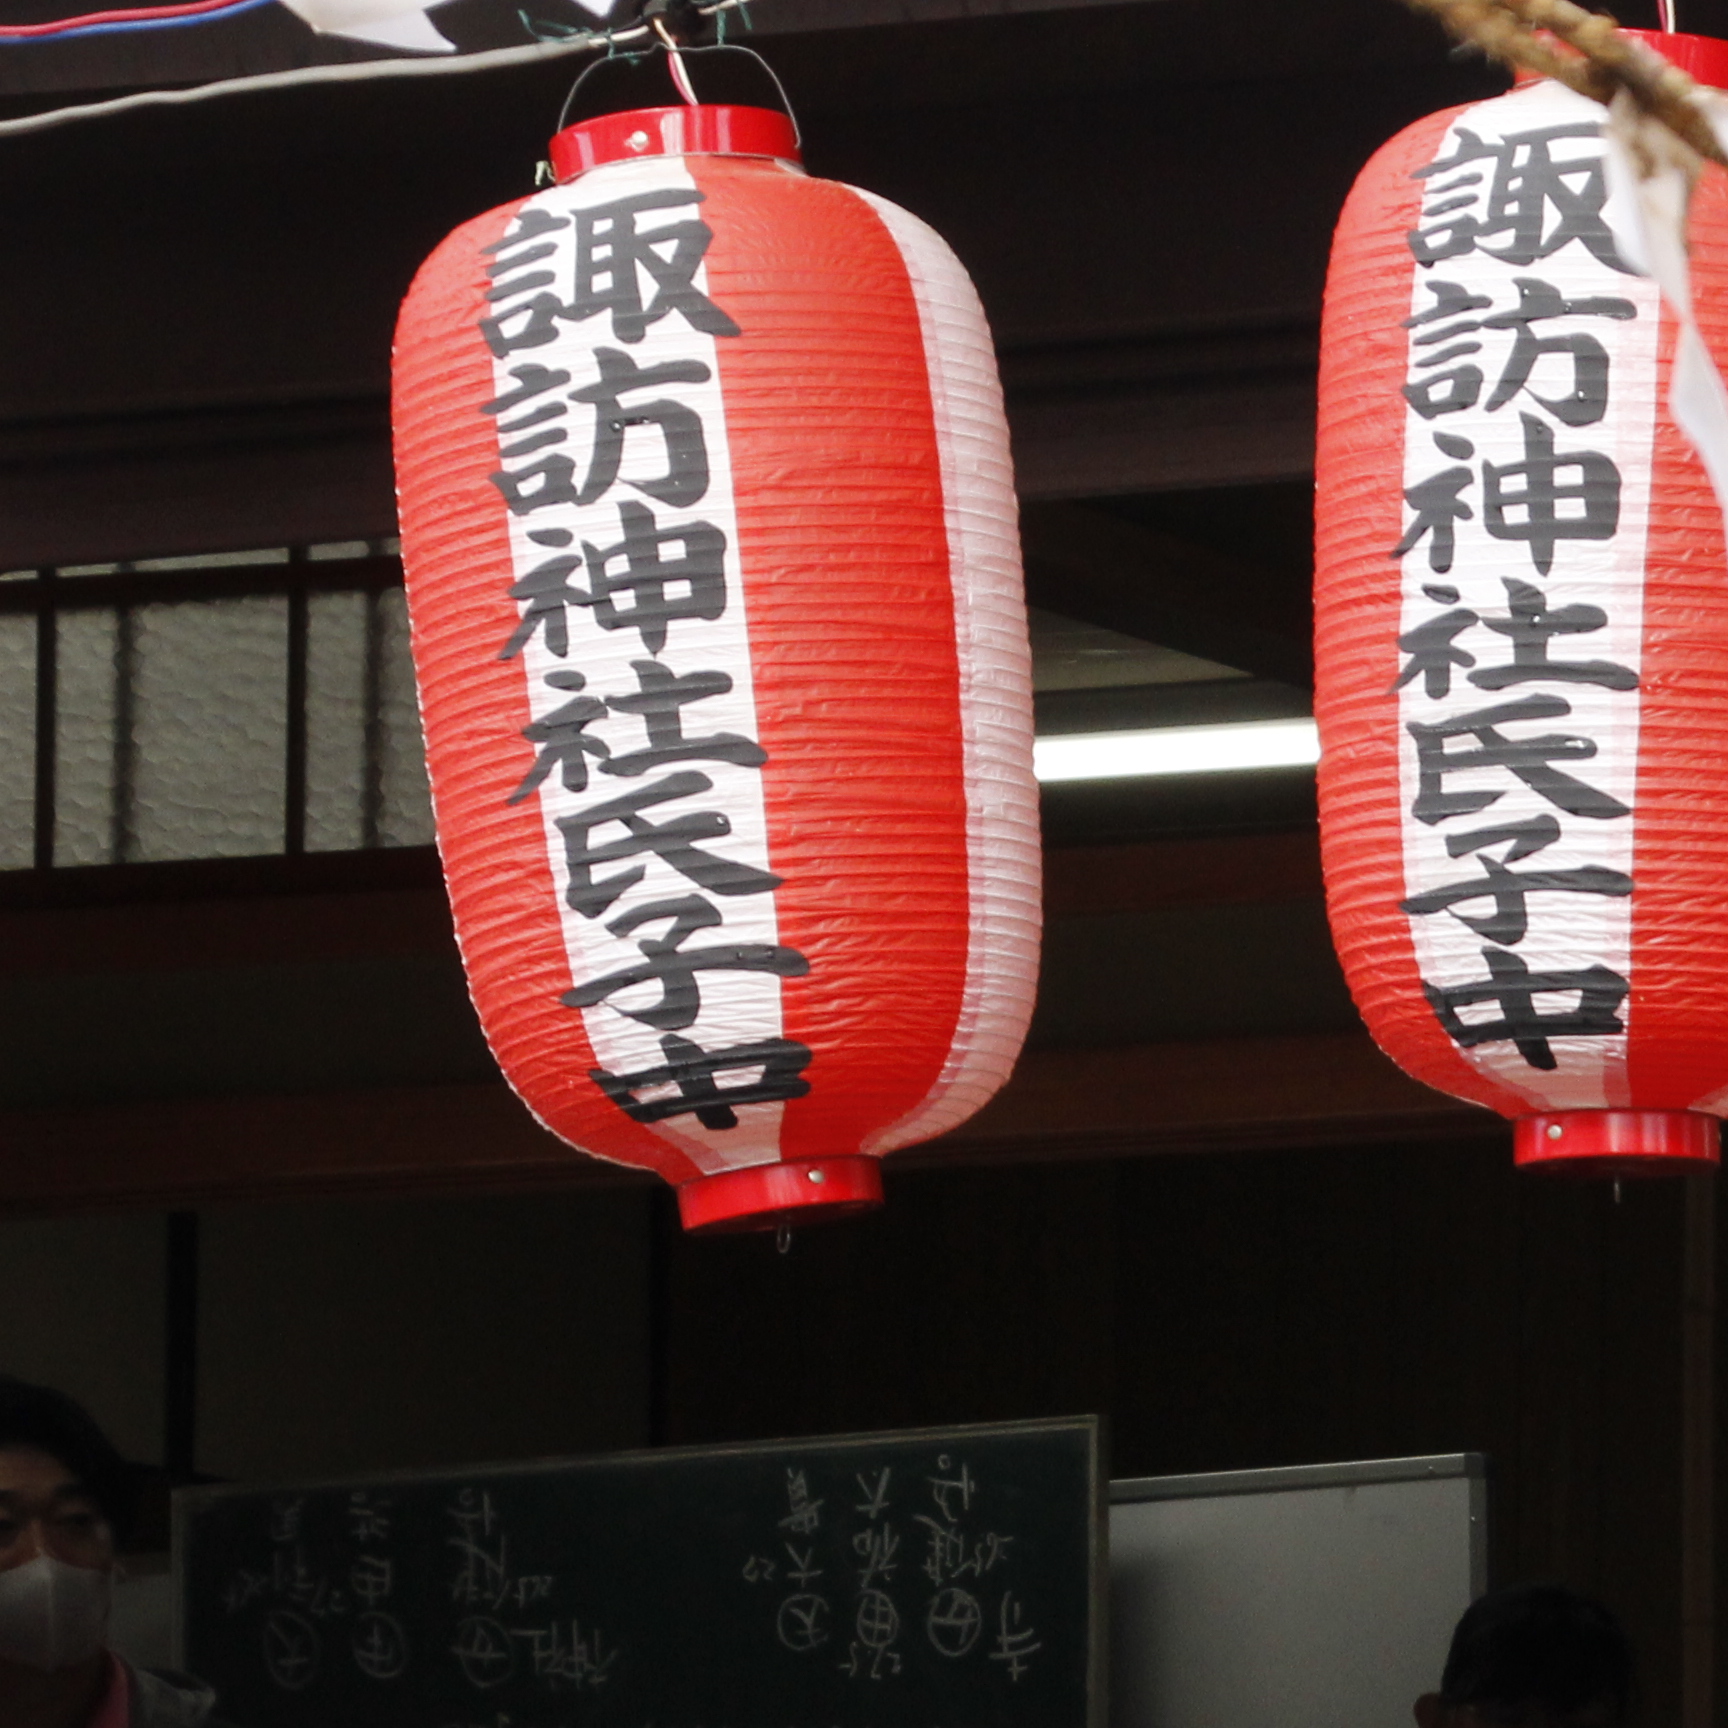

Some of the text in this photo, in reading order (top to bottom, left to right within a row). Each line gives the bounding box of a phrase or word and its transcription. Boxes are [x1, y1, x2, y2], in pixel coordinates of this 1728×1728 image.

[479, 188, 811, 1131] 諏訪神社氏子中
[1387, 120, 1655, 1070] 諏訪神社氏子中
